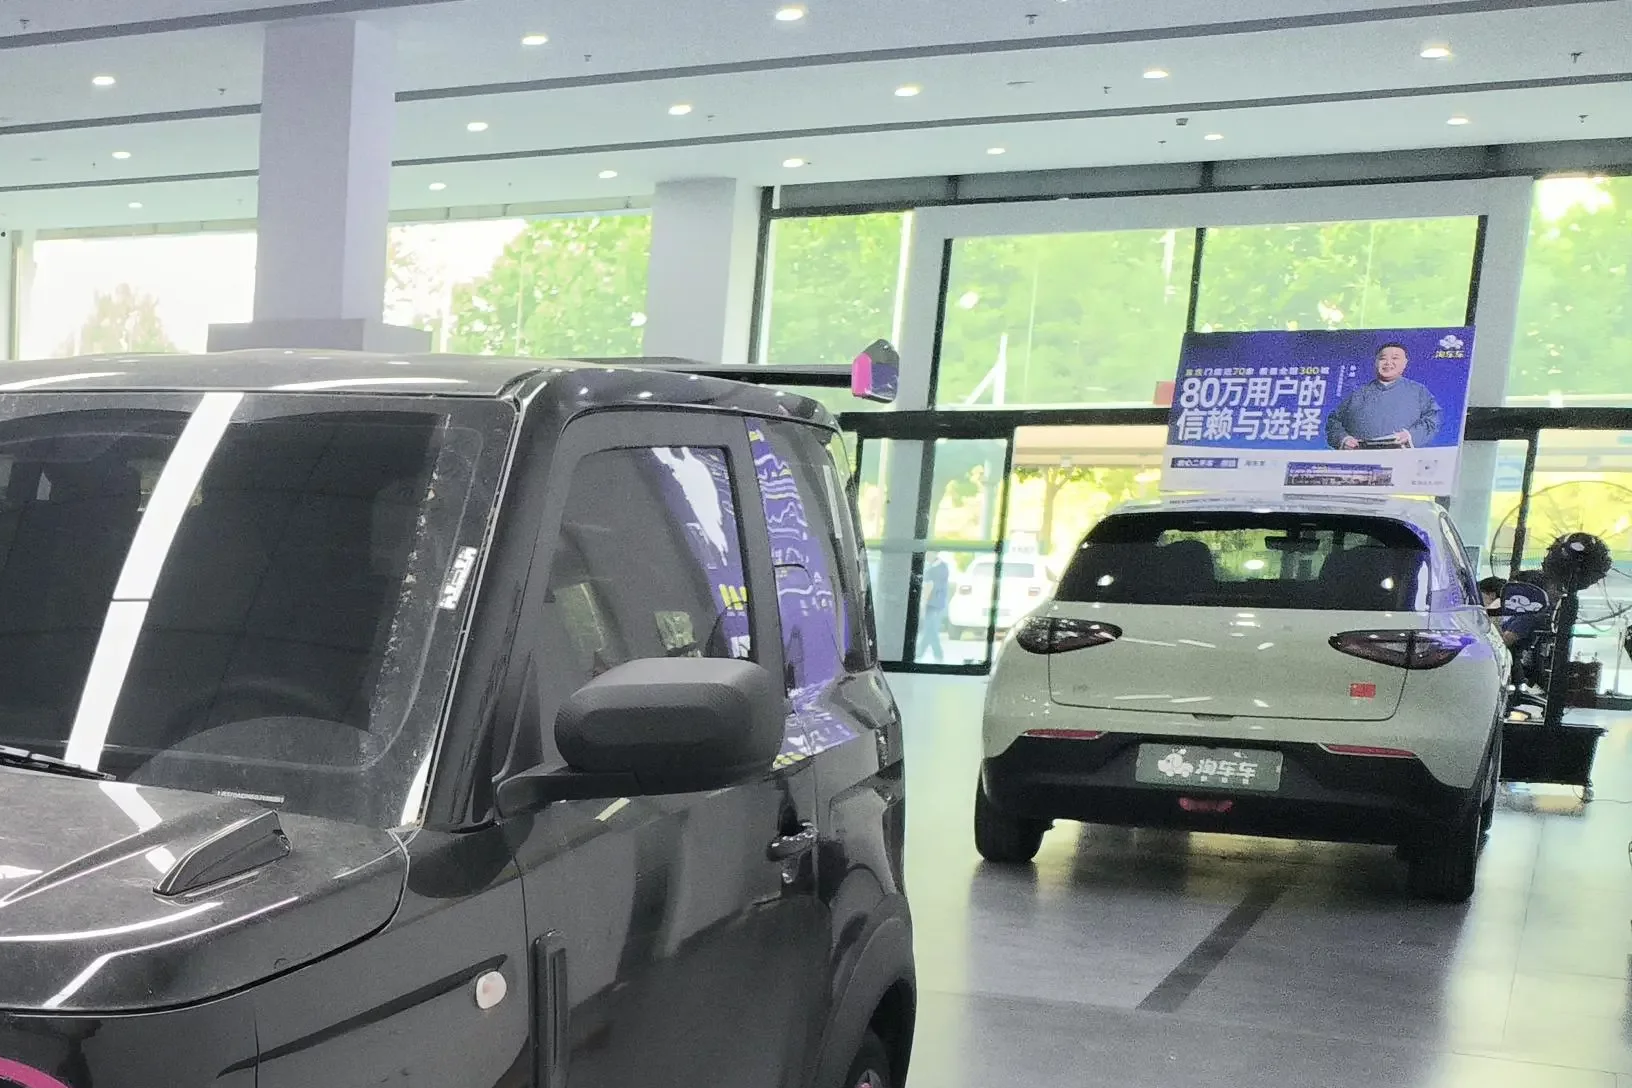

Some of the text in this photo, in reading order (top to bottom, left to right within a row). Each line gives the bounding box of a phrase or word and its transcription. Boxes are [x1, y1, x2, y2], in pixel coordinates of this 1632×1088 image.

[1180, 376, 1327, 409] 80万用户的
[1176, 407, 1322, 441] 信赖与选择
